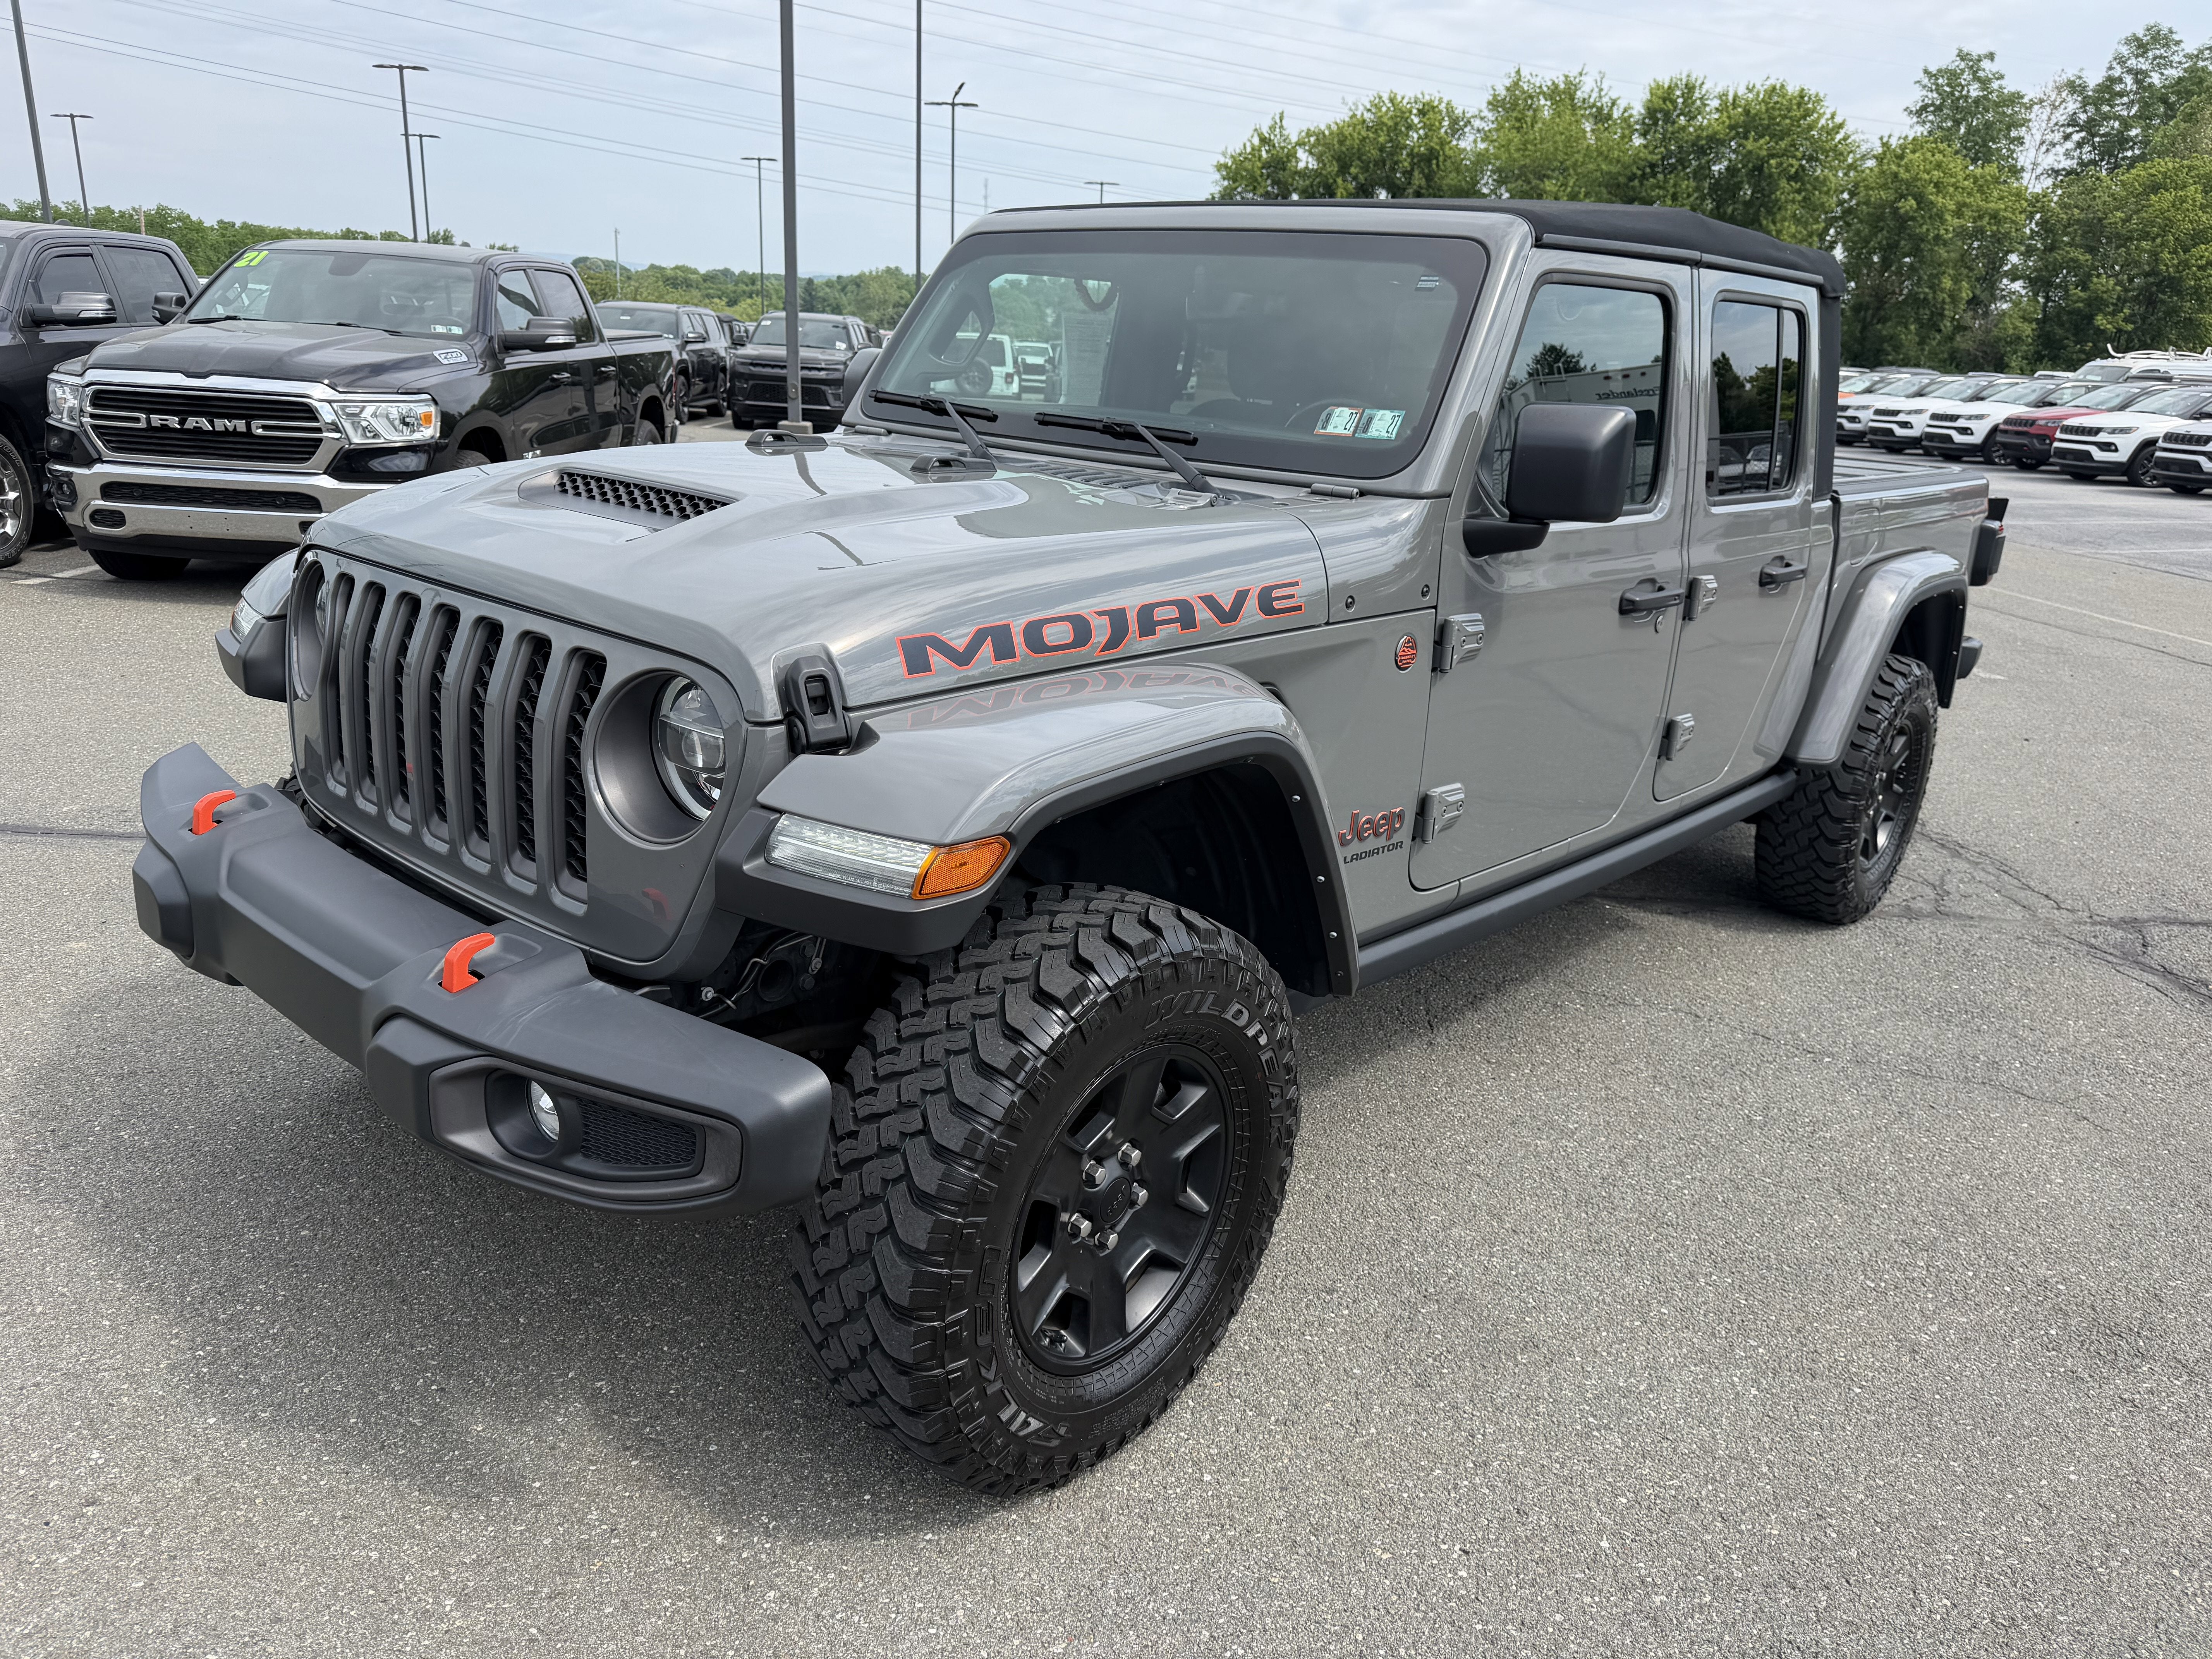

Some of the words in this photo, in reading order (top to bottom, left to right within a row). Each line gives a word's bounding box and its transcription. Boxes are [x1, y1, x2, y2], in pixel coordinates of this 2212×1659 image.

[234, 251, 269, 267] 21
[149, 414, 247, 433] RAM
[1343, 411, 1358, 431] 27
[1386, 414, 1401, 434] 27
[895, 578, 1305, 679] MOJAVE
[1338, 807, 1405, 846] Jeep
[1143, 990, 1284, 1149] WILDPEAK
[975, 1244, 1072, 1448] FALKEN
